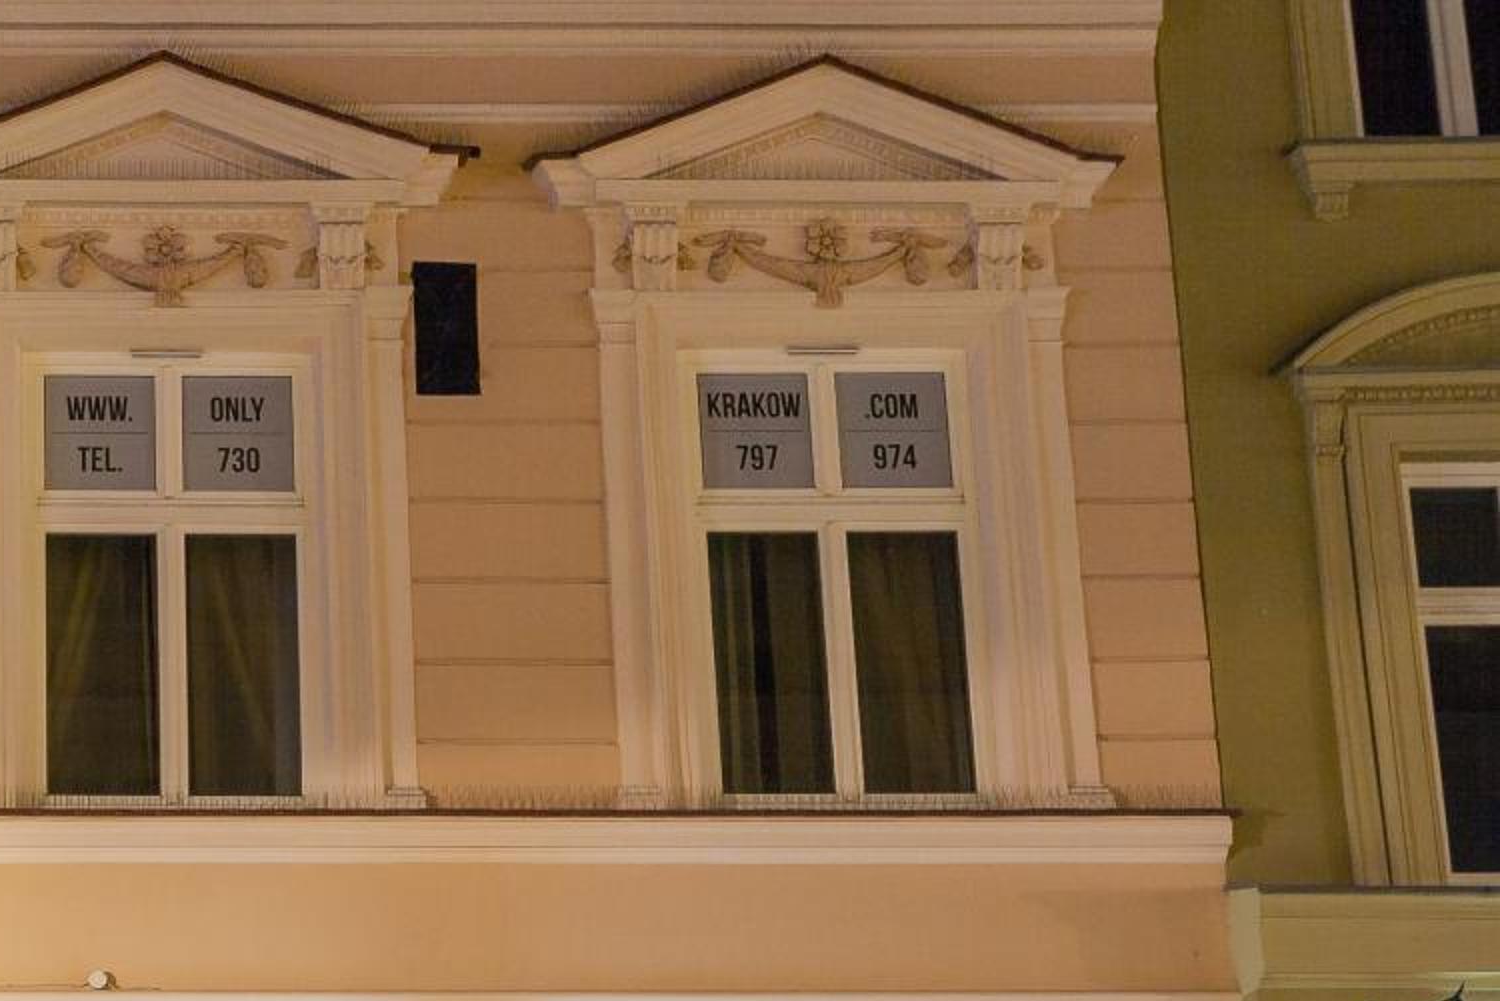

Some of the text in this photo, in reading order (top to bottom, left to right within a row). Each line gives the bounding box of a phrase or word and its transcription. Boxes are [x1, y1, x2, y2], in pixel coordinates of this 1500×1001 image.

[67, 397, 133, 422] WWW.
[211, 397, 265, 422] ONLY
[707, 393, 800, 418] KRAKOW
[865, 394, 918, 418] .COM
[78, 447, 123, 472] TEL.
[218, 448, 260, 473] 730
[736, 446, 778, 470] 797
[873, 445, 917, 469] 974
